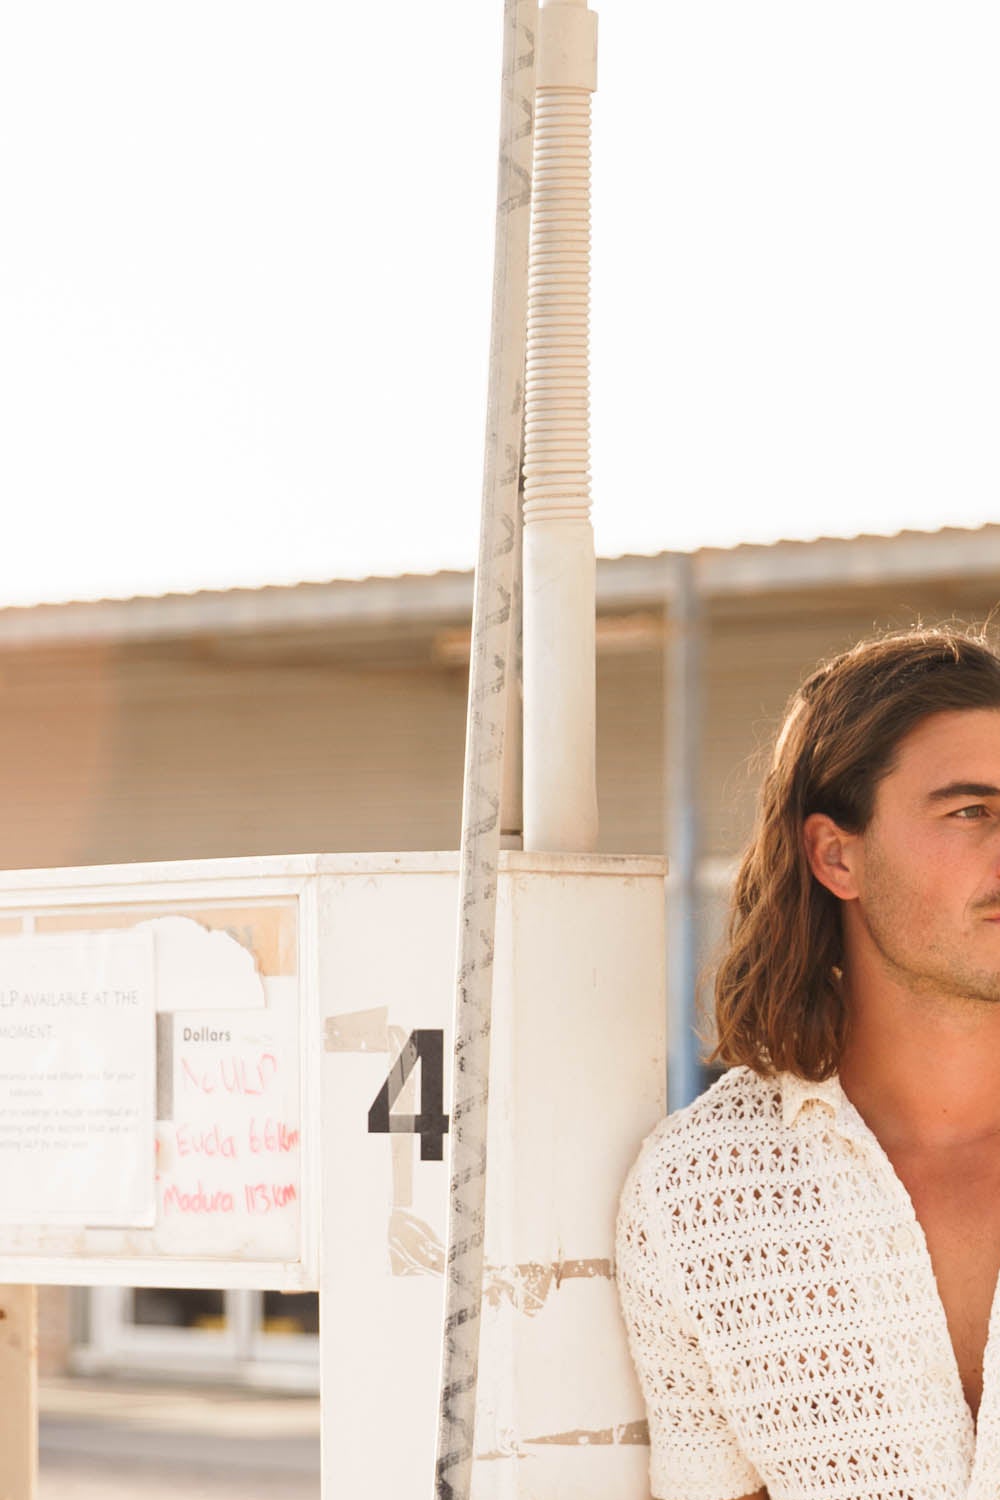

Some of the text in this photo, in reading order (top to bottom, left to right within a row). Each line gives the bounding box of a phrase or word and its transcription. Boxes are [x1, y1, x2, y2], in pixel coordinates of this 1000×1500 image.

[0, 990, 139, 1008] LP AVAILABLE AT THE
[183, 1027, 232, 1042] Dollars
[219, 1053, 278, 1096] ULP
[368, 1029, 450, 1161] 4
[176, 1123, 236, 1158] Eucla
[163, 1180, 235, 1215] Madura
